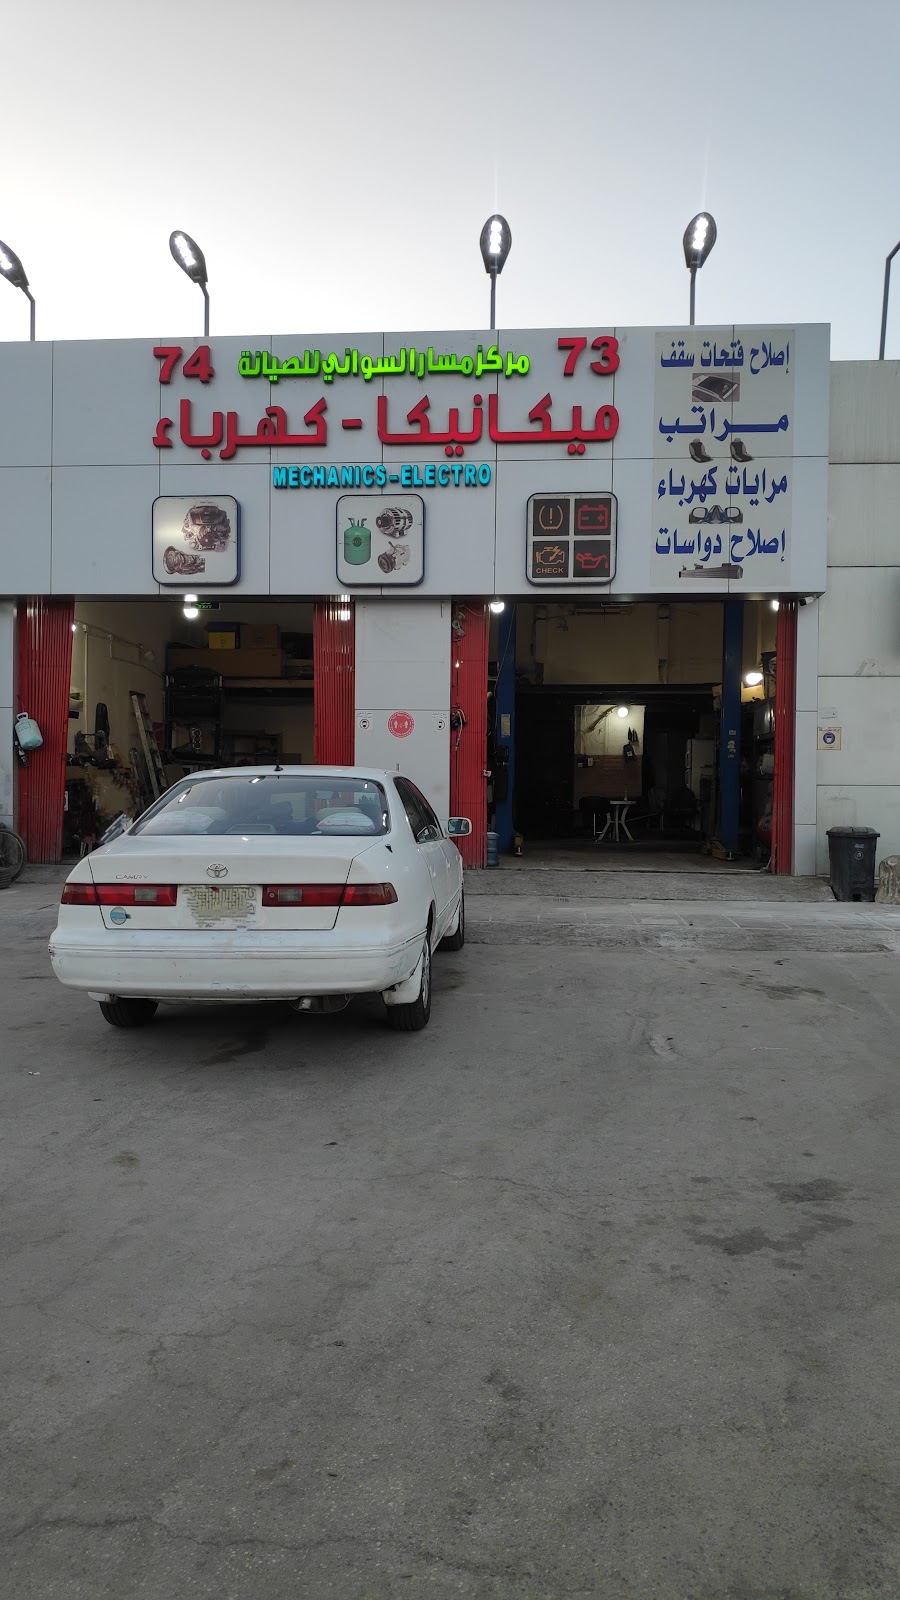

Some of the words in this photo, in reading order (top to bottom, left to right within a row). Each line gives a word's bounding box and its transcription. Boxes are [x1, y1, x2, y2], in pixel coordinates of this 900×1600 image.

[153, 345, 214, 384] 74
[238, 350, 320, 384] للصيانة
[322, 348, 416, 384] السواني
[417, 347, 474, 379] مسار
[475, 345, 531, 378] مركز
[558, 336, 621, 377] 73
[660, 340, 695, 368] سقف
[700, 339, 745, 367] فتحات
[749, 341, 790, 374] إصلاح
[152, 396, 329, 460] كهرباء
[377, 392, 620, 457] ميكانيكا
[658, 406, 789, 443] مراتب
[657, 466, 718, 507] كهرباء
[725, 466, 788, 506] مرايات
[655, 527, 722, 562] دواسات
[730, 528, 786, 563] إصلاح
